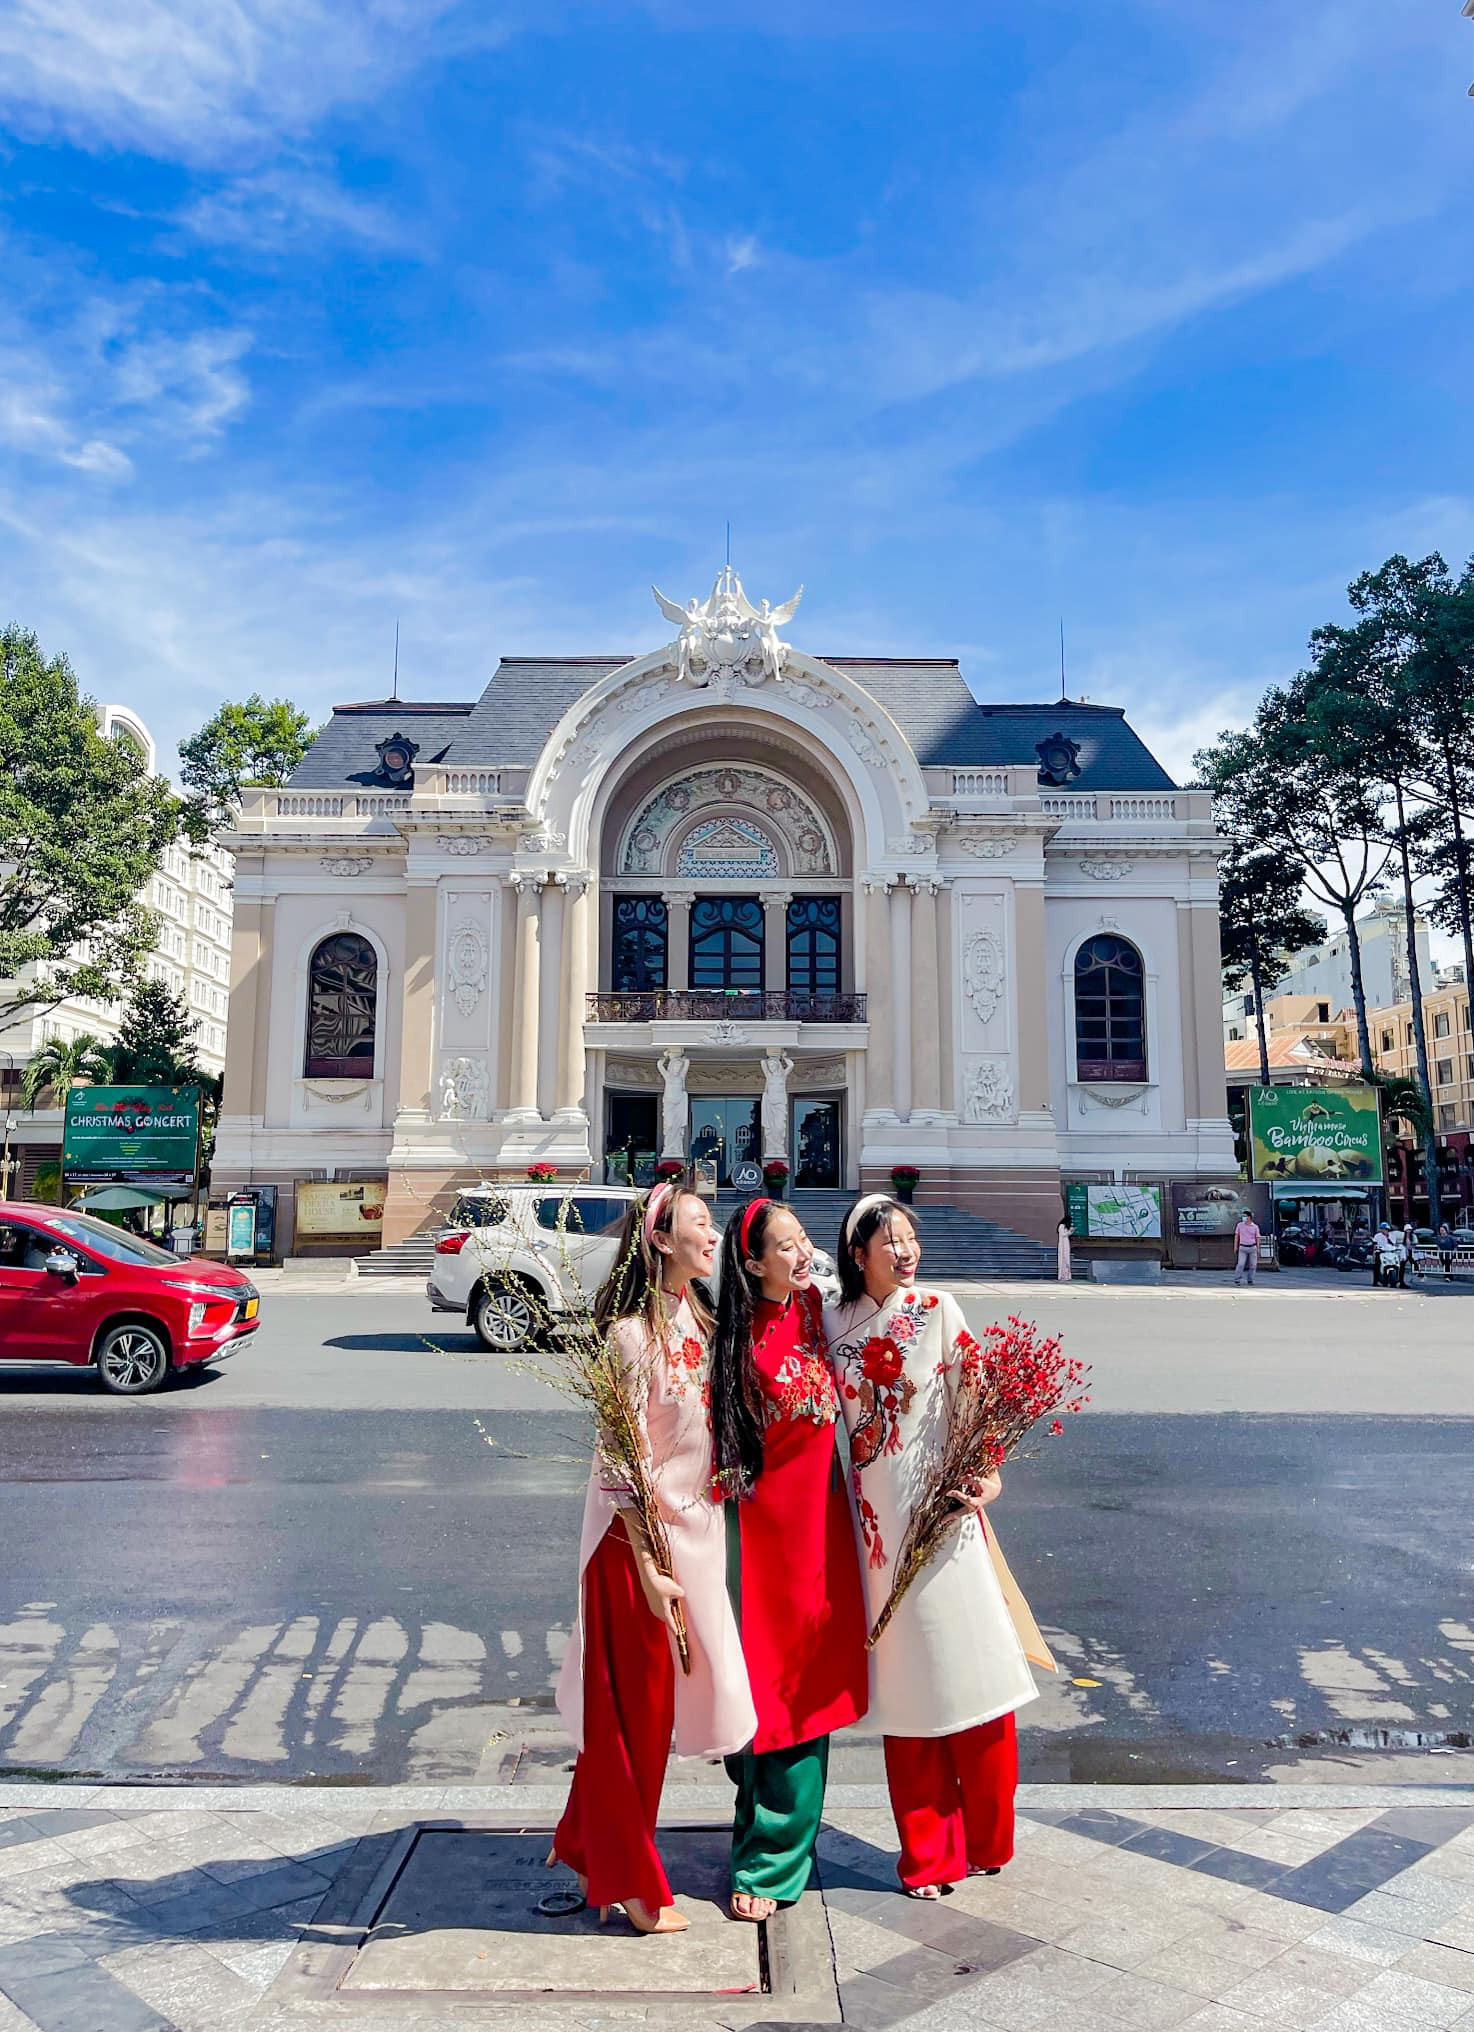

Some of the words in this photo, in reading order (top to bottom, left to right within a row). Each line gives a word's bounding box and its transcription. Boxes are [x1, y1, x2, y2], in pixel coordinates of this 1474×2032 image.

[70, 1115, 131, 1128] CHRISTMAS
[135, 1115, 193, 1128] CONCERT
[1290, 1117, 1347, 1133] Vietnamese
[1267, 1127, 1334, 1148] Bamboo
[1334, 1131, 1368, 1148] Circus
